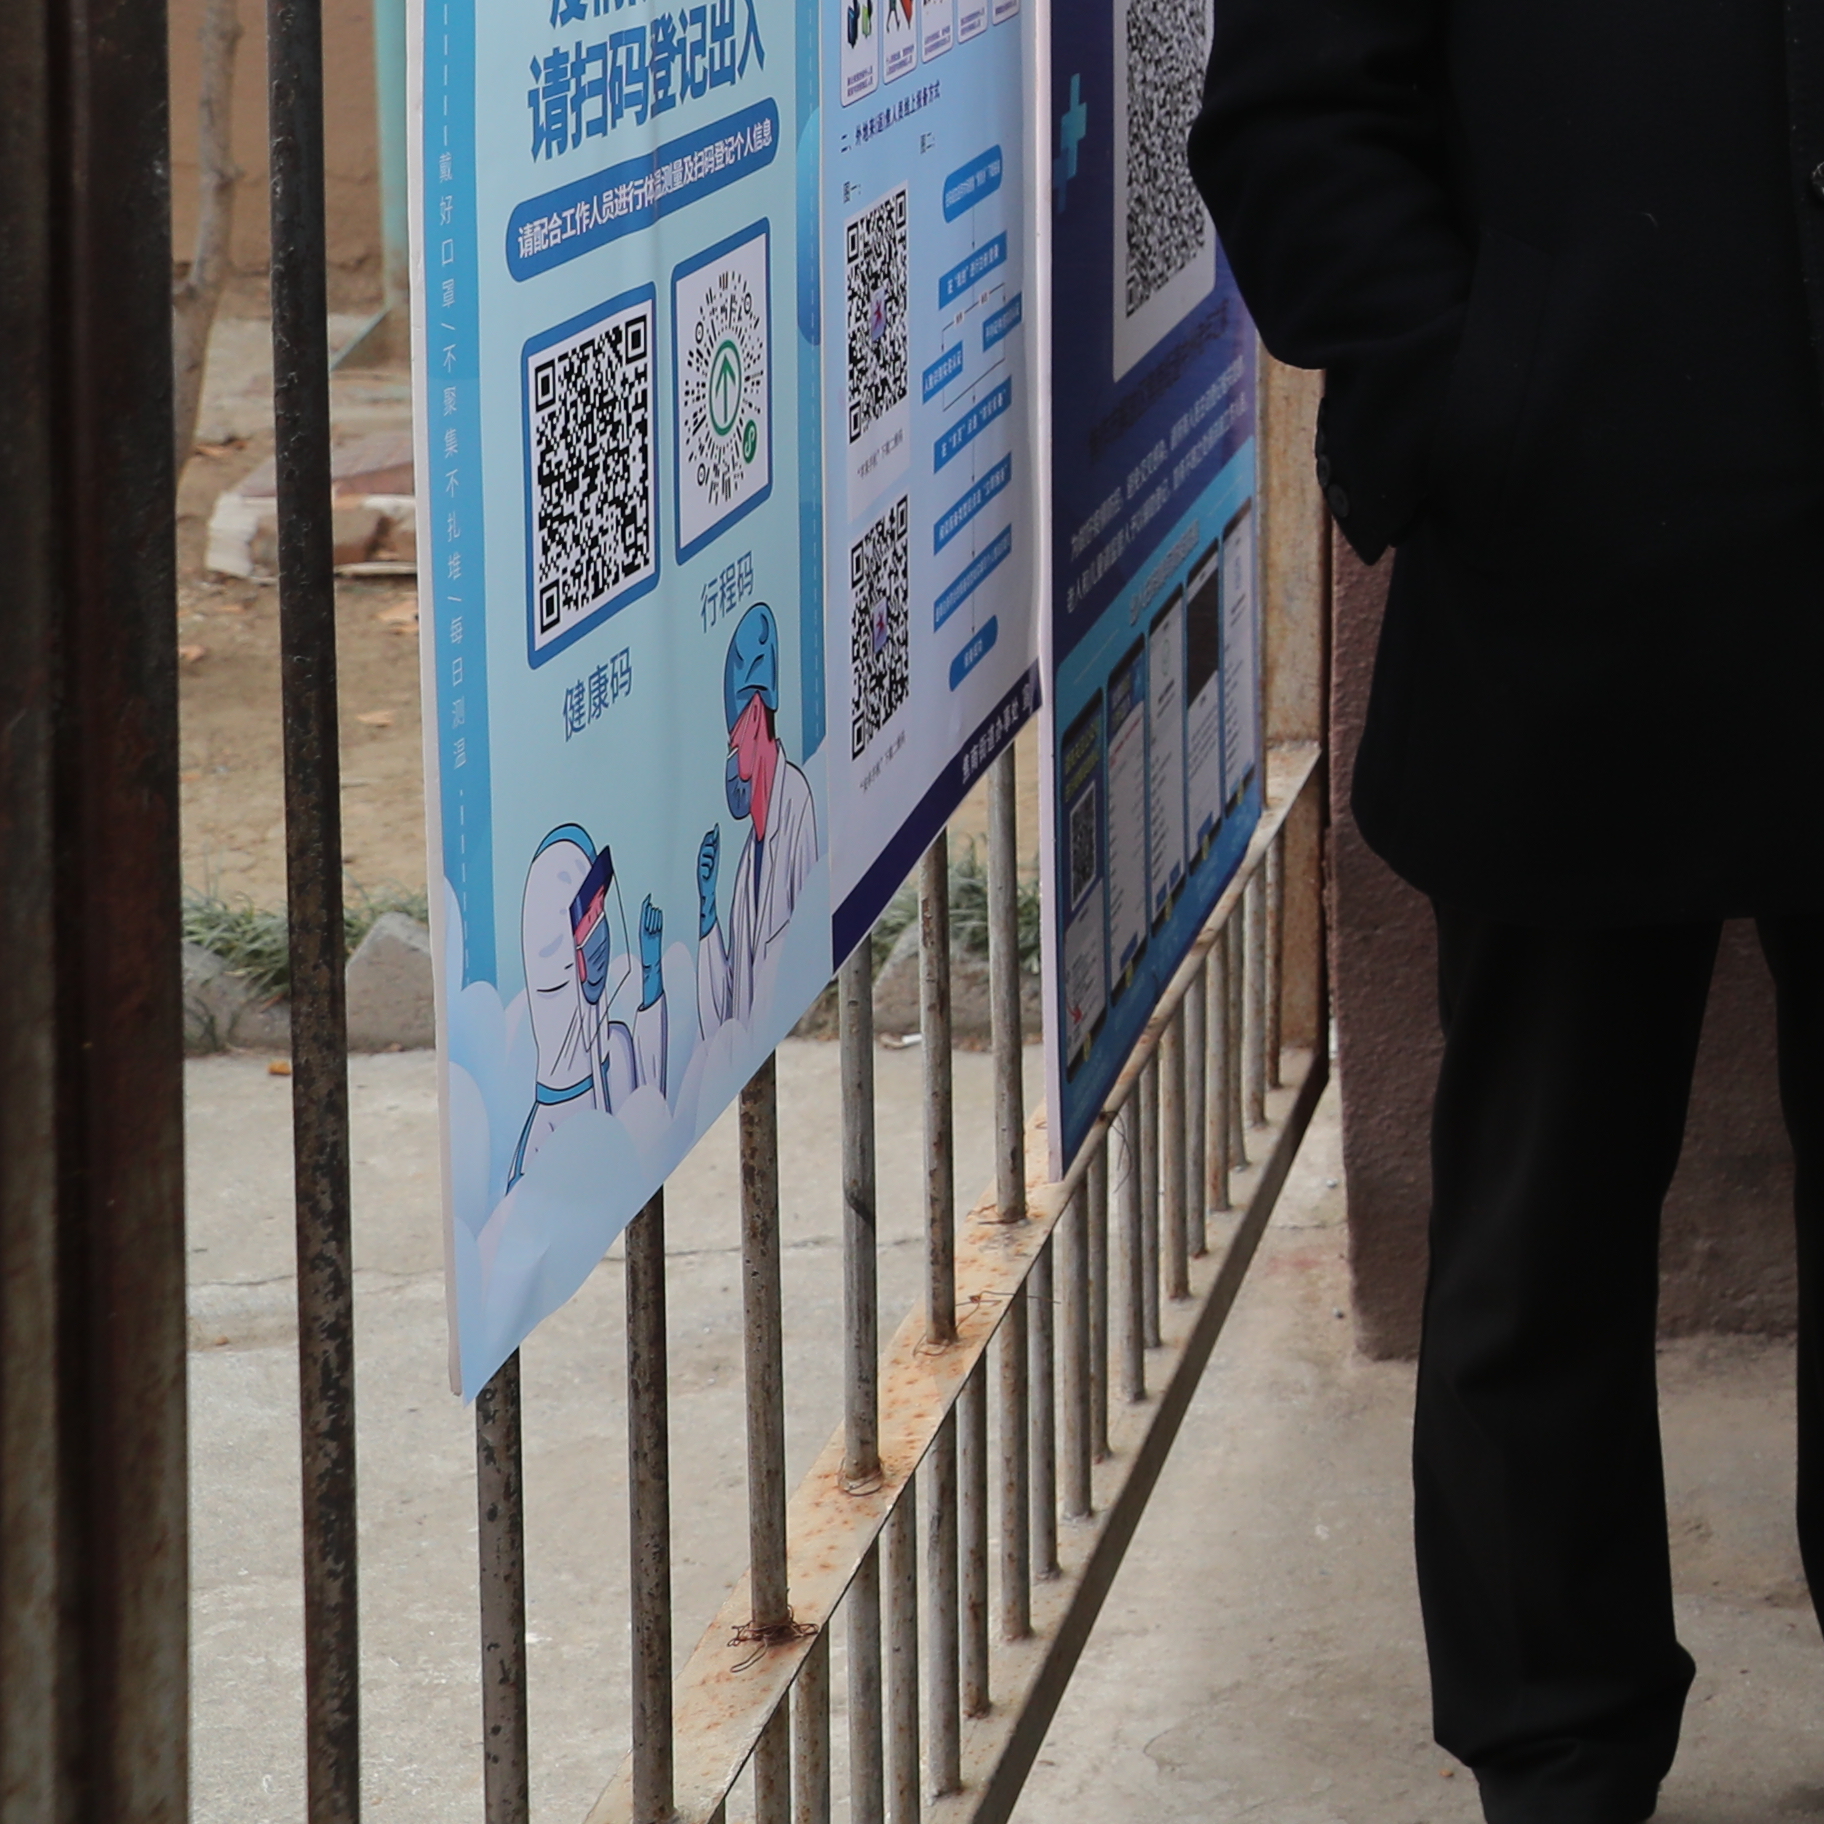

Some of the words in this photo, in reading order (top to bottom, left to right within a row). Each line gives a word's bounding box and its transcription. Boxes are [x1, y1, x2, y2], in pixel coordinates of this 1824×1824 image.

[517, 116, 773, 260] 请配合工作人员进行体温测量及扫码登记个人信息
[701, 550, 754, 634] 行程码
[563, 646, 633, 743] 健康码
